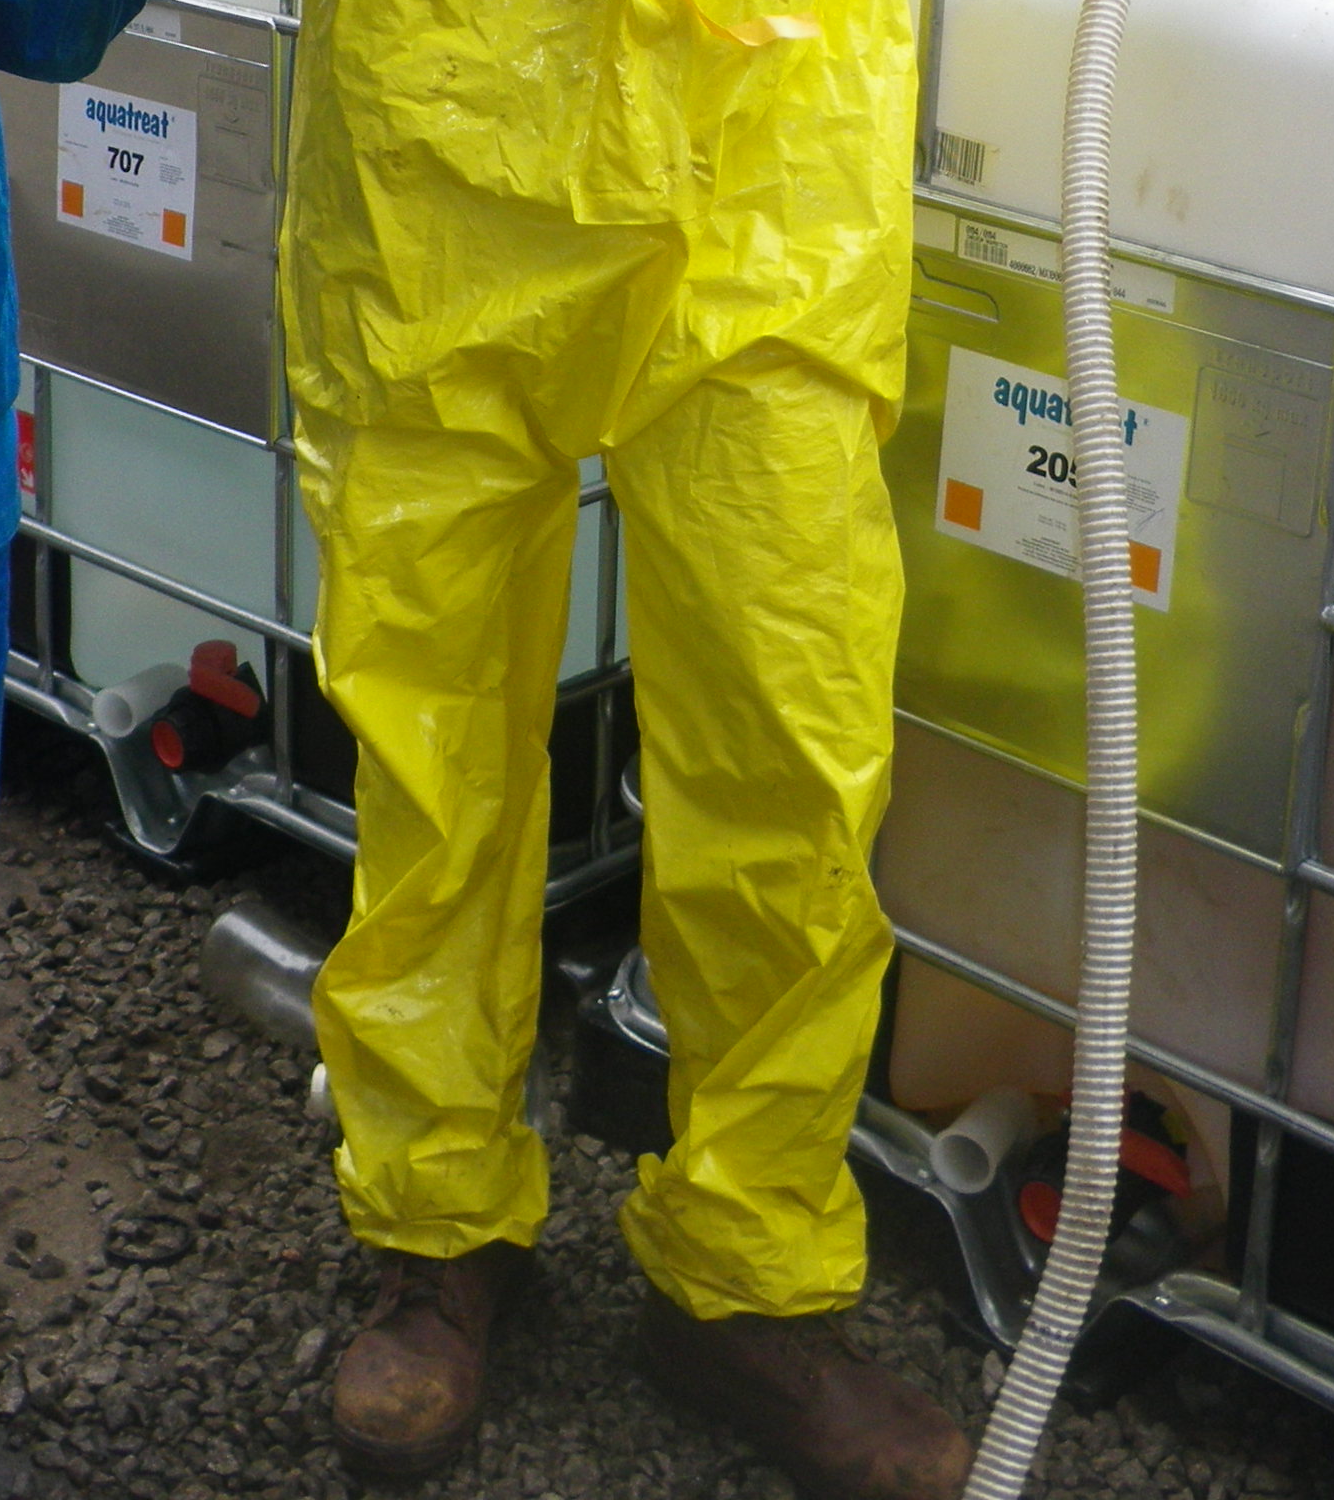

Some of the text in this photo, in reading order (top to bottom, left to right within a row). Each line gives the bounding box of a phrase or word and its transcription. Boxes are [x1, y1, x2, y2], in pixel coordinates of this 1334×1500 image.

[86, 97, 169, 139] aquatreat
[107, 146, 144, 176] 707
[994, 376, 1138, 446] aquatt
